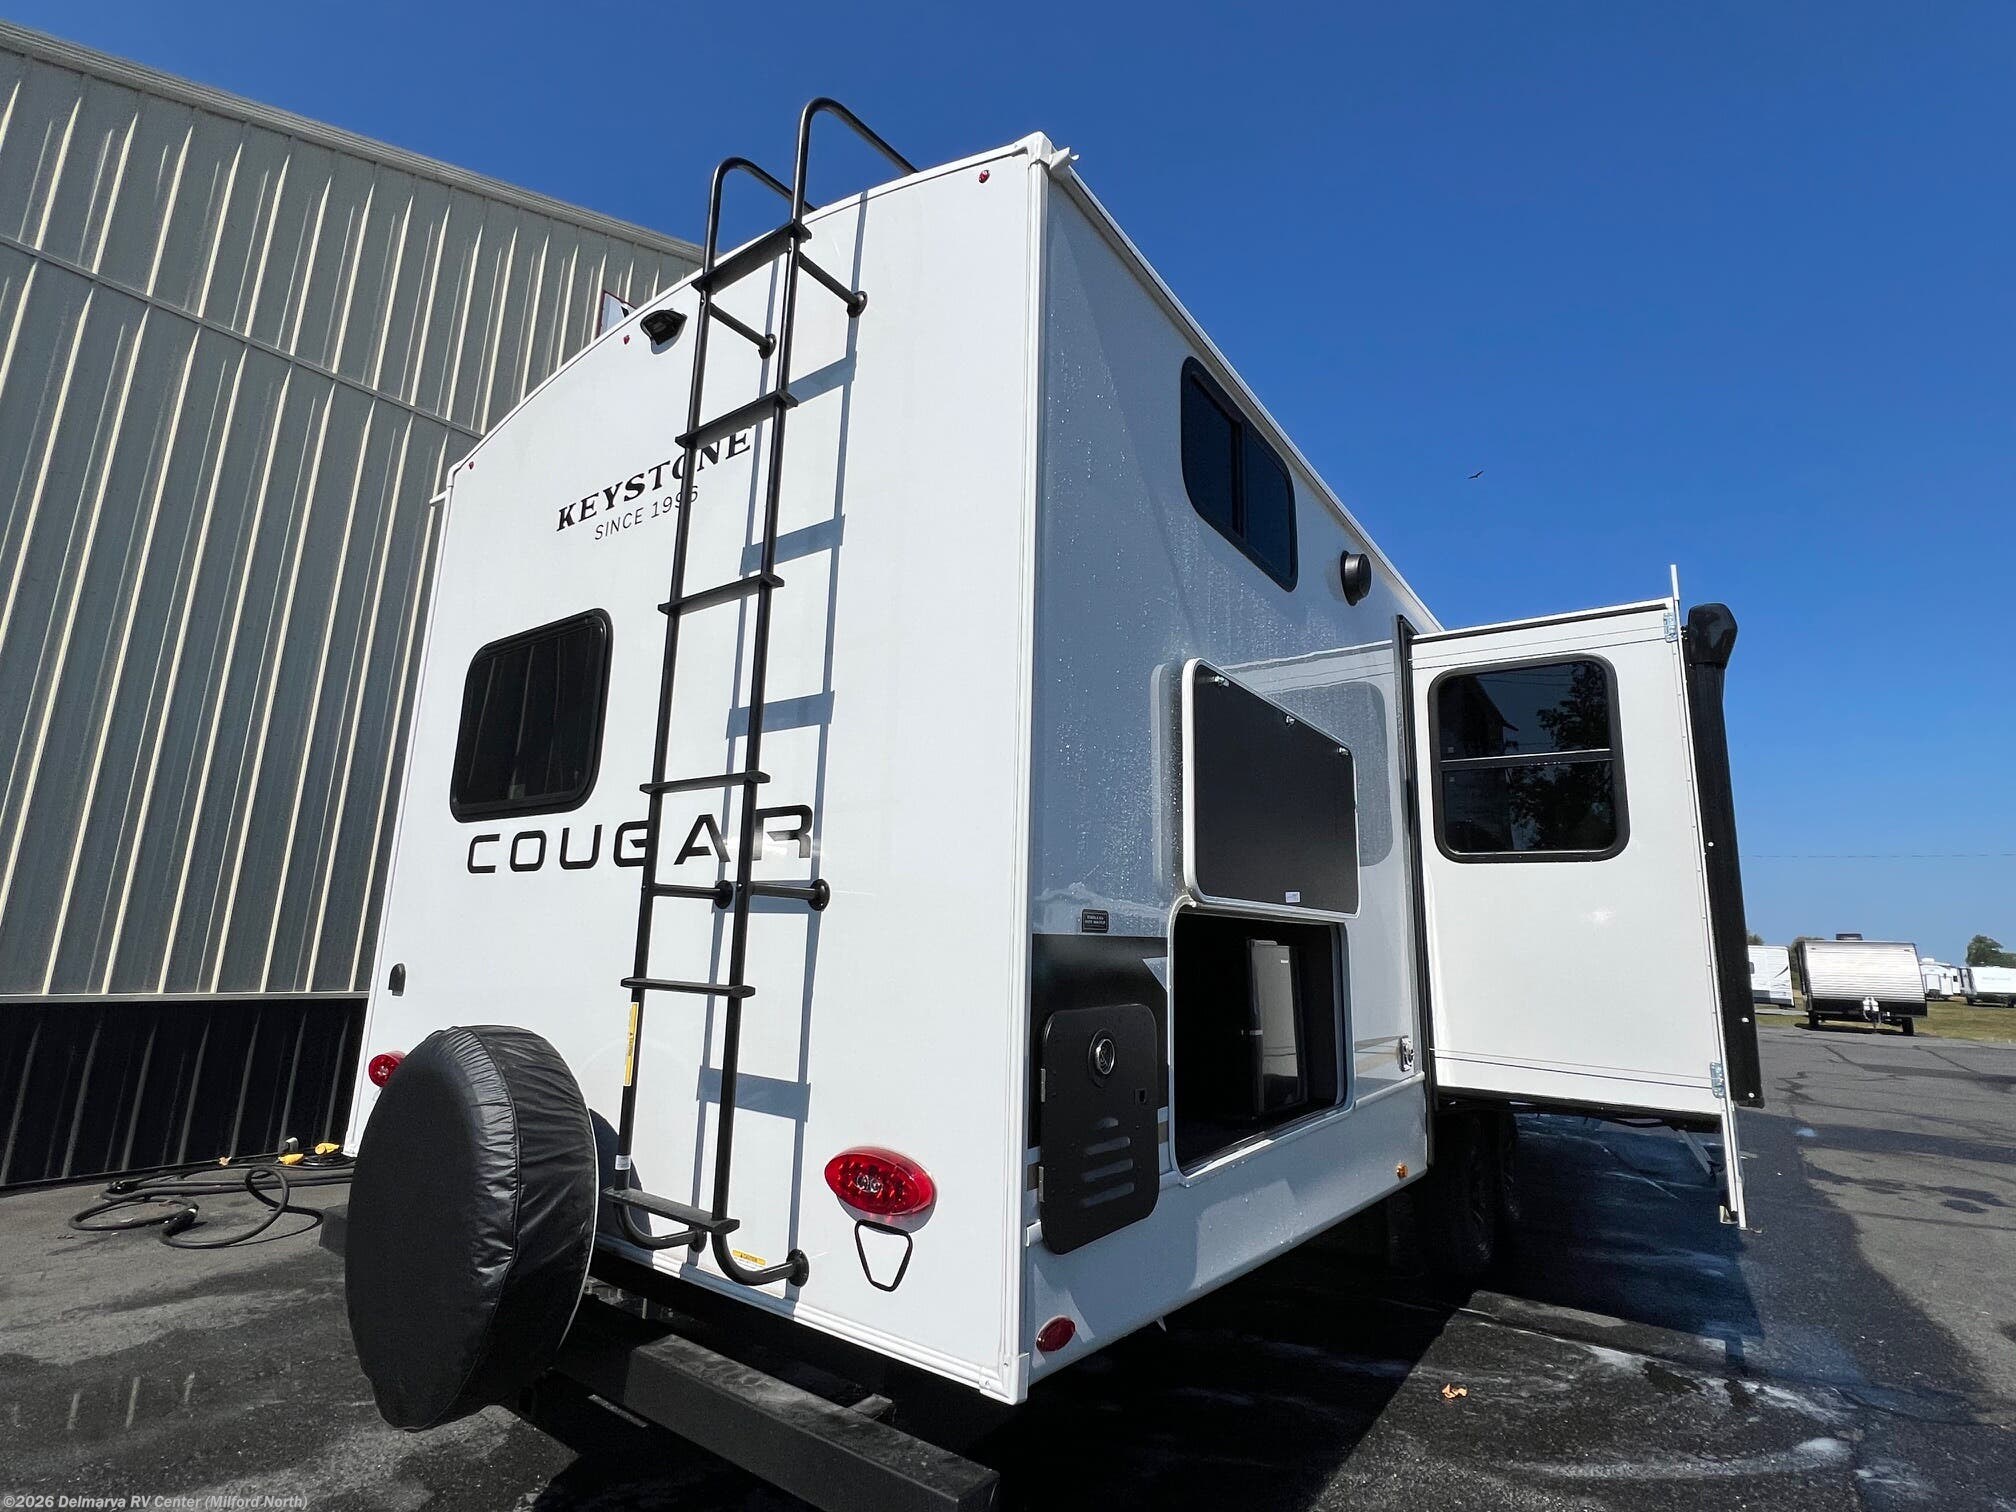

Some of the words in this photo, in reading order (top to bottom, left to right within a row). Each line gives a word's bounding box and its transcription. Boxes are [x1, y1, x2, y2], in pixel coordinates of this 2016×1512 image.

[556, 427, 751, 532] KEYSTONE
[595, 507, 644, 540] SINCE
[651, 485, 699, 519] 1996
[468, 804, 813, 874] COUGAR
